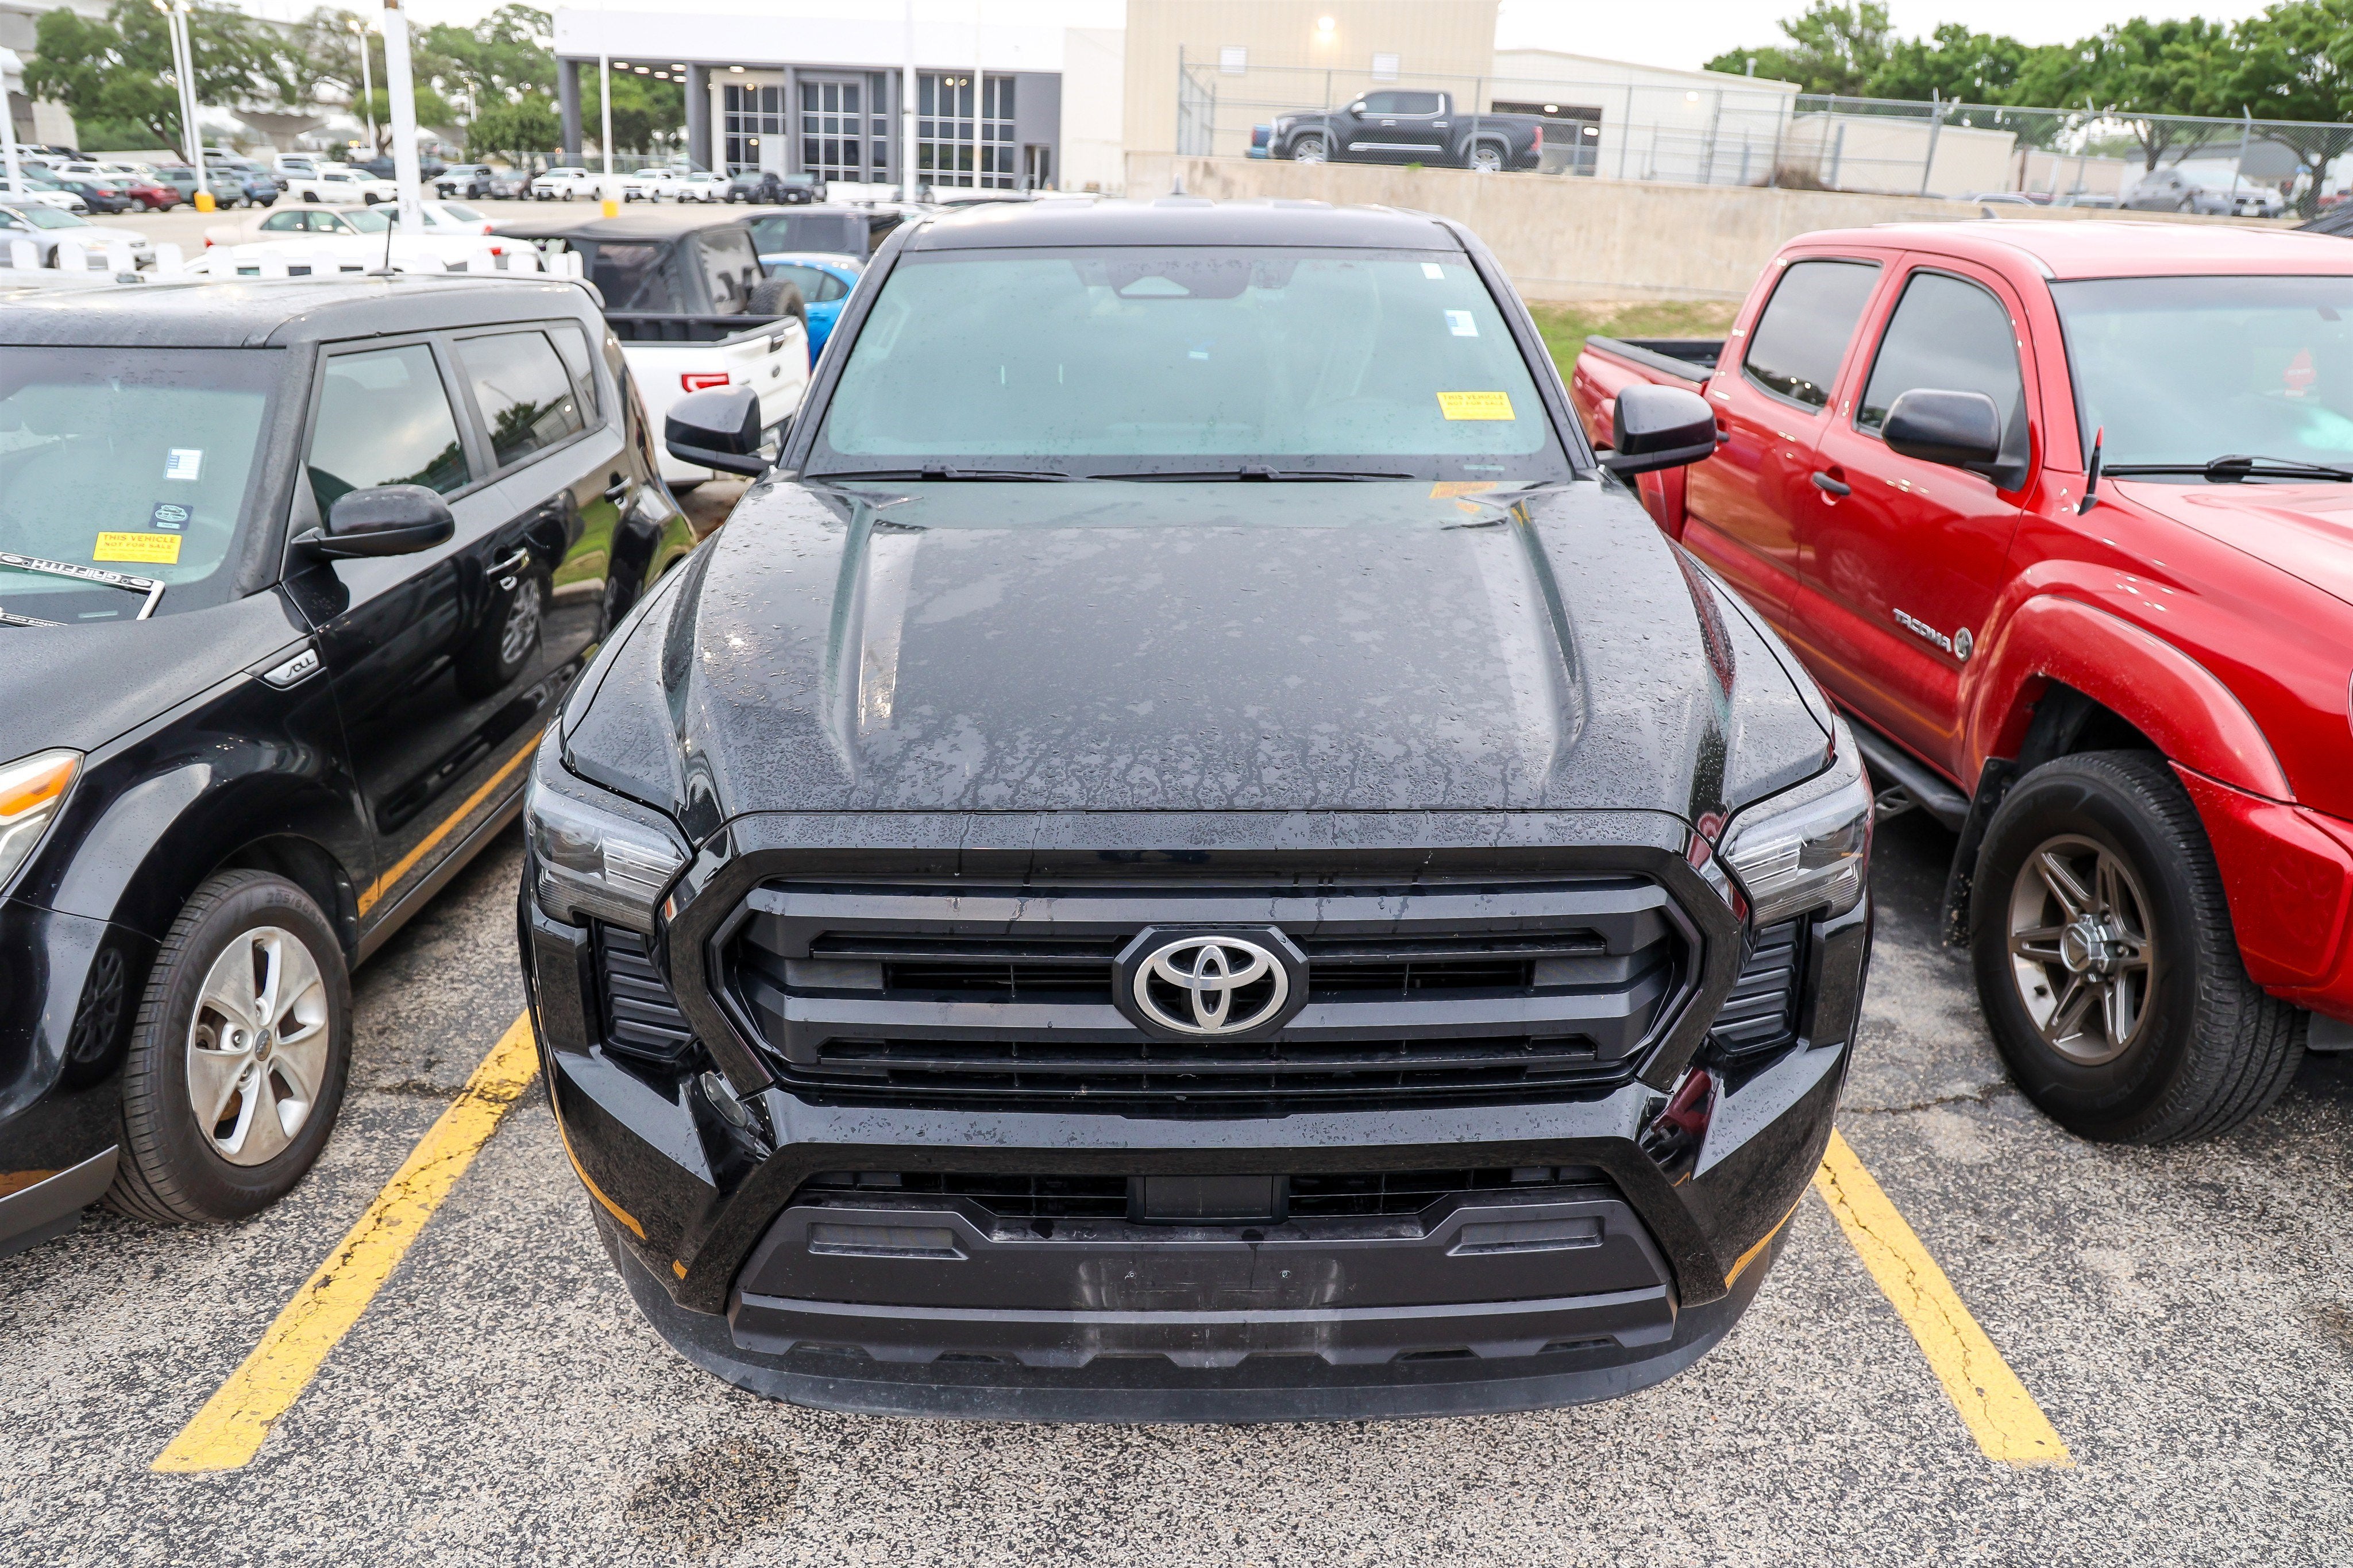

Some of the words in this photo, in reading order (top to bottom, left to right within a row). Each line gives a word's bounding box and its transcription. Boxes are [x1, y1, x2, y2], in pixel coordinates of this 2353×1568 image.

[131, 535, 176, 543] VEHICLE
[30, 559, 122, 583] GRIFFITH
[1892, 608, 1953, 654] TACOMA
